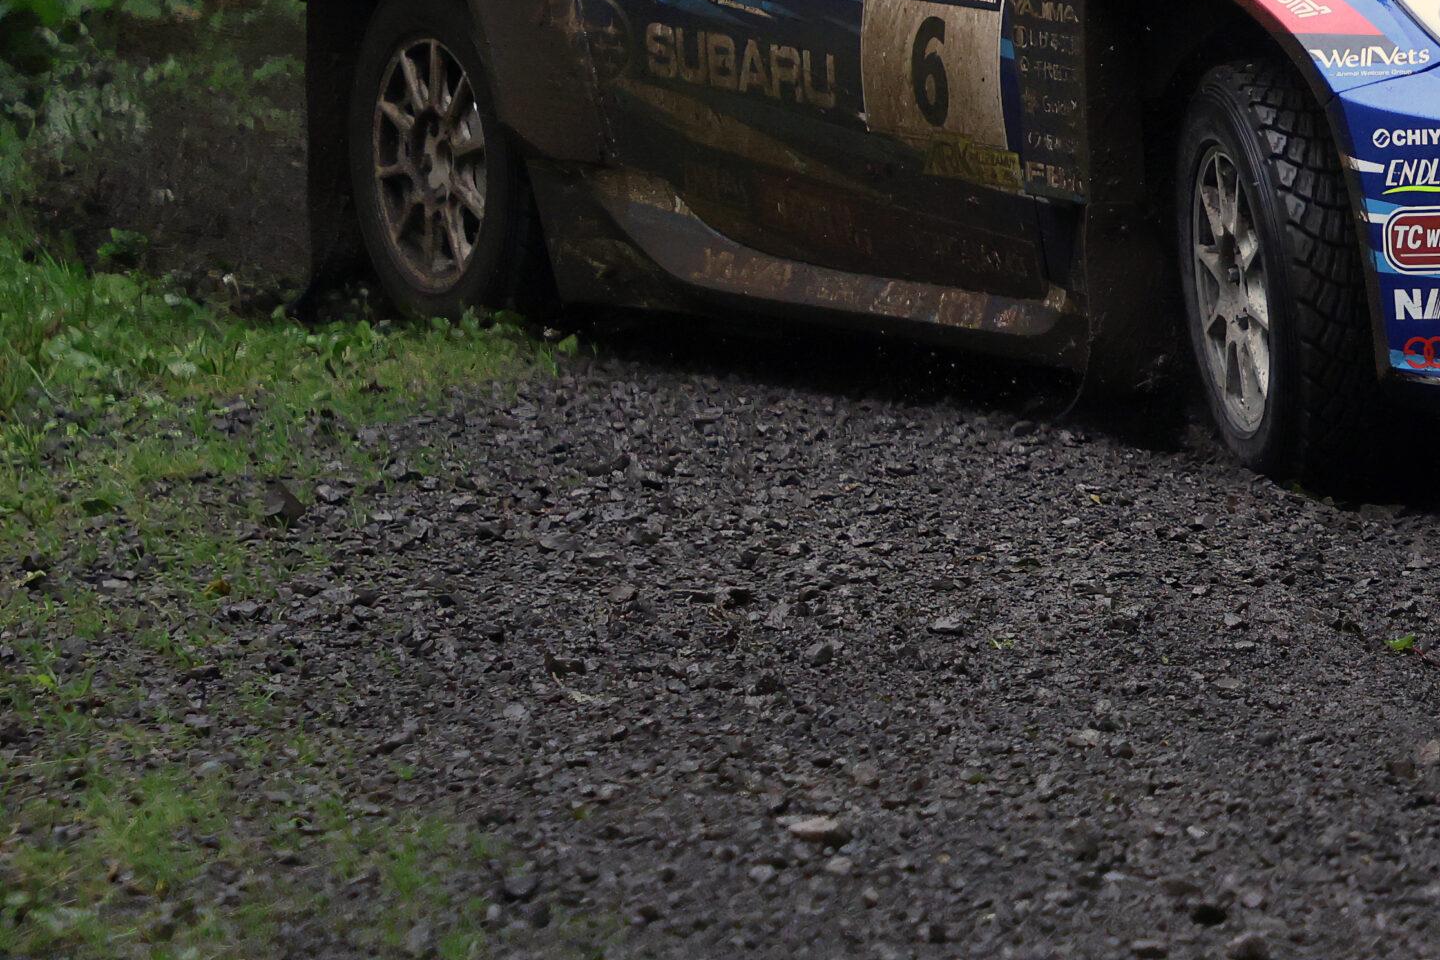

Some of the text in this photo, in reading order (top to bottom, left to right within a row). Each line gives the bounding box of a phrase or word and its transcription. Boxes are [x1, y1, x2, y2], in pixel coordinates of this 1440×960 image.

[645, 21, 837, 108] SUBARU
[911, 16, 949, 127] 6
[1308, 45, 1430, 69] WellVets
[1394, 224, 1422, 250] TC
